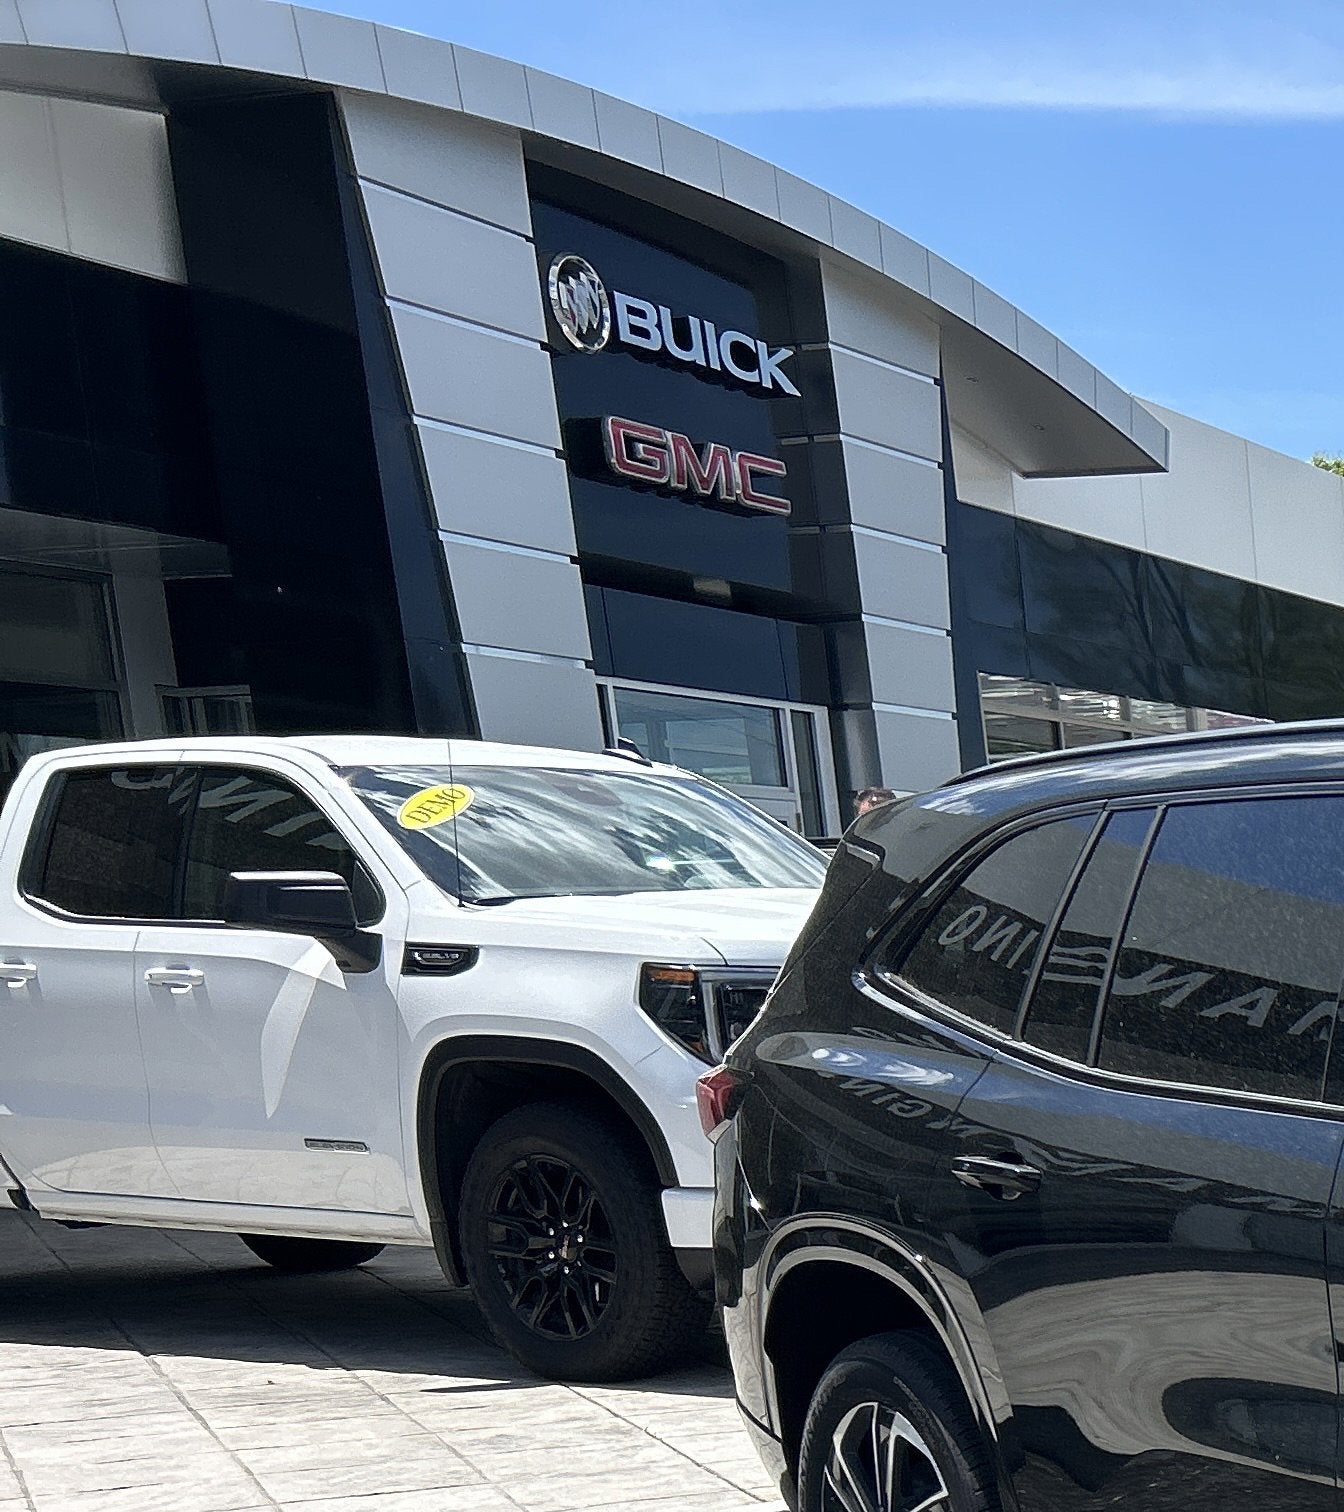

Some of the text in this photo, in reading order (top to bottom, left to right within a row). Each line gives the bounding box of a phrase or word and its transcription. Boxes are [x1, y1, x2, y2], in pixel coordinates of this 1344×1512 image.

[612, 290, 802, 397] BUICK
[605, 415, 792, 516] GMC
[405, 788, 466, 823] DEMO
